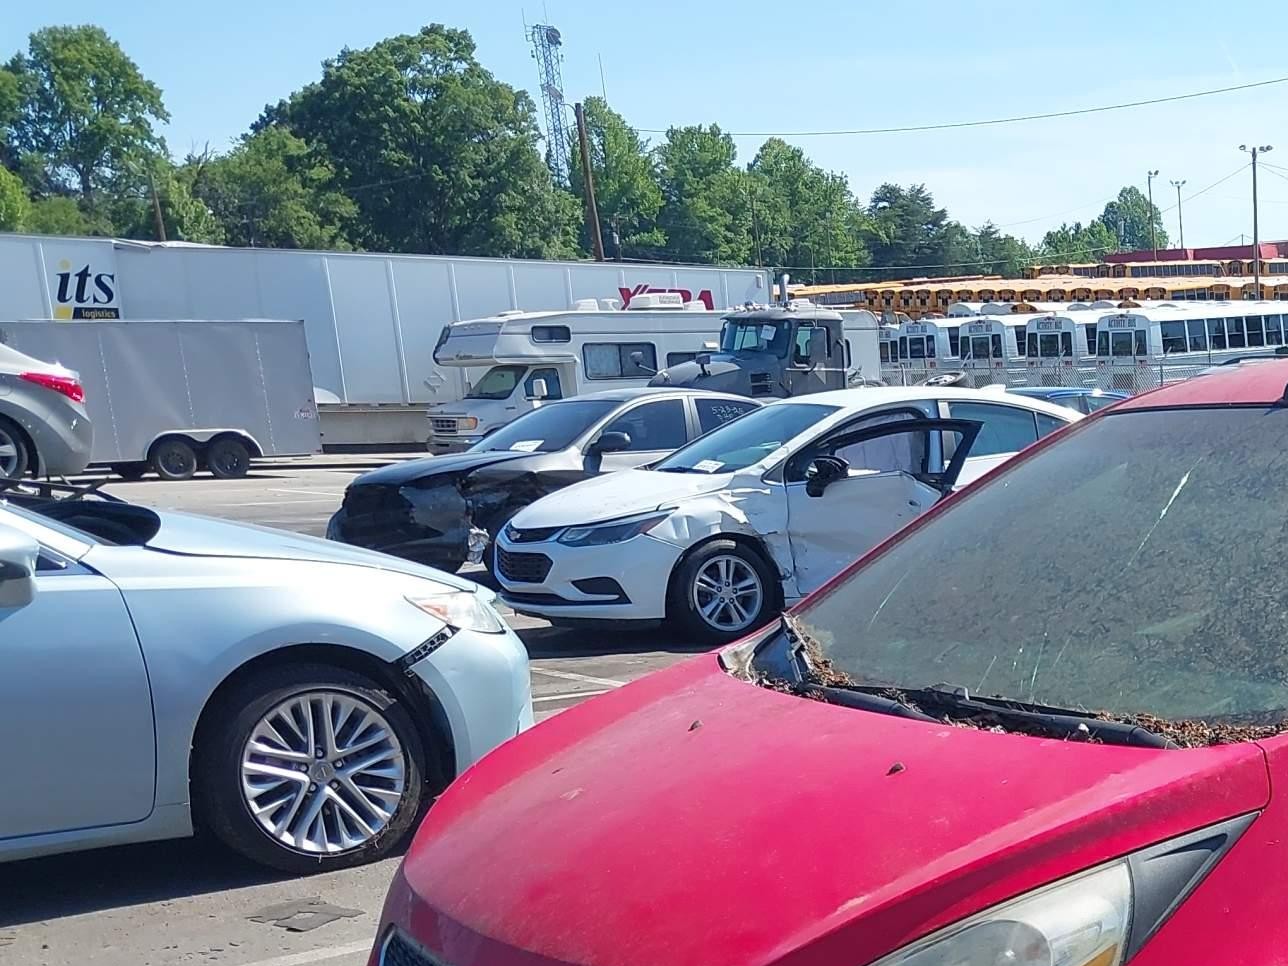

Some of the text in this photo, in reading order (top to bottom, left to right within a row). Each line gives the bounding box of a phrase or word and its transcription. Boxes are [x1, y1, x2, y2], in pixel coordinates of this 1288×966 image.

[56, 258, 115, 304] its
[618, 284, 715, 311] XRA
[81, 308, 116, 319] logistics
